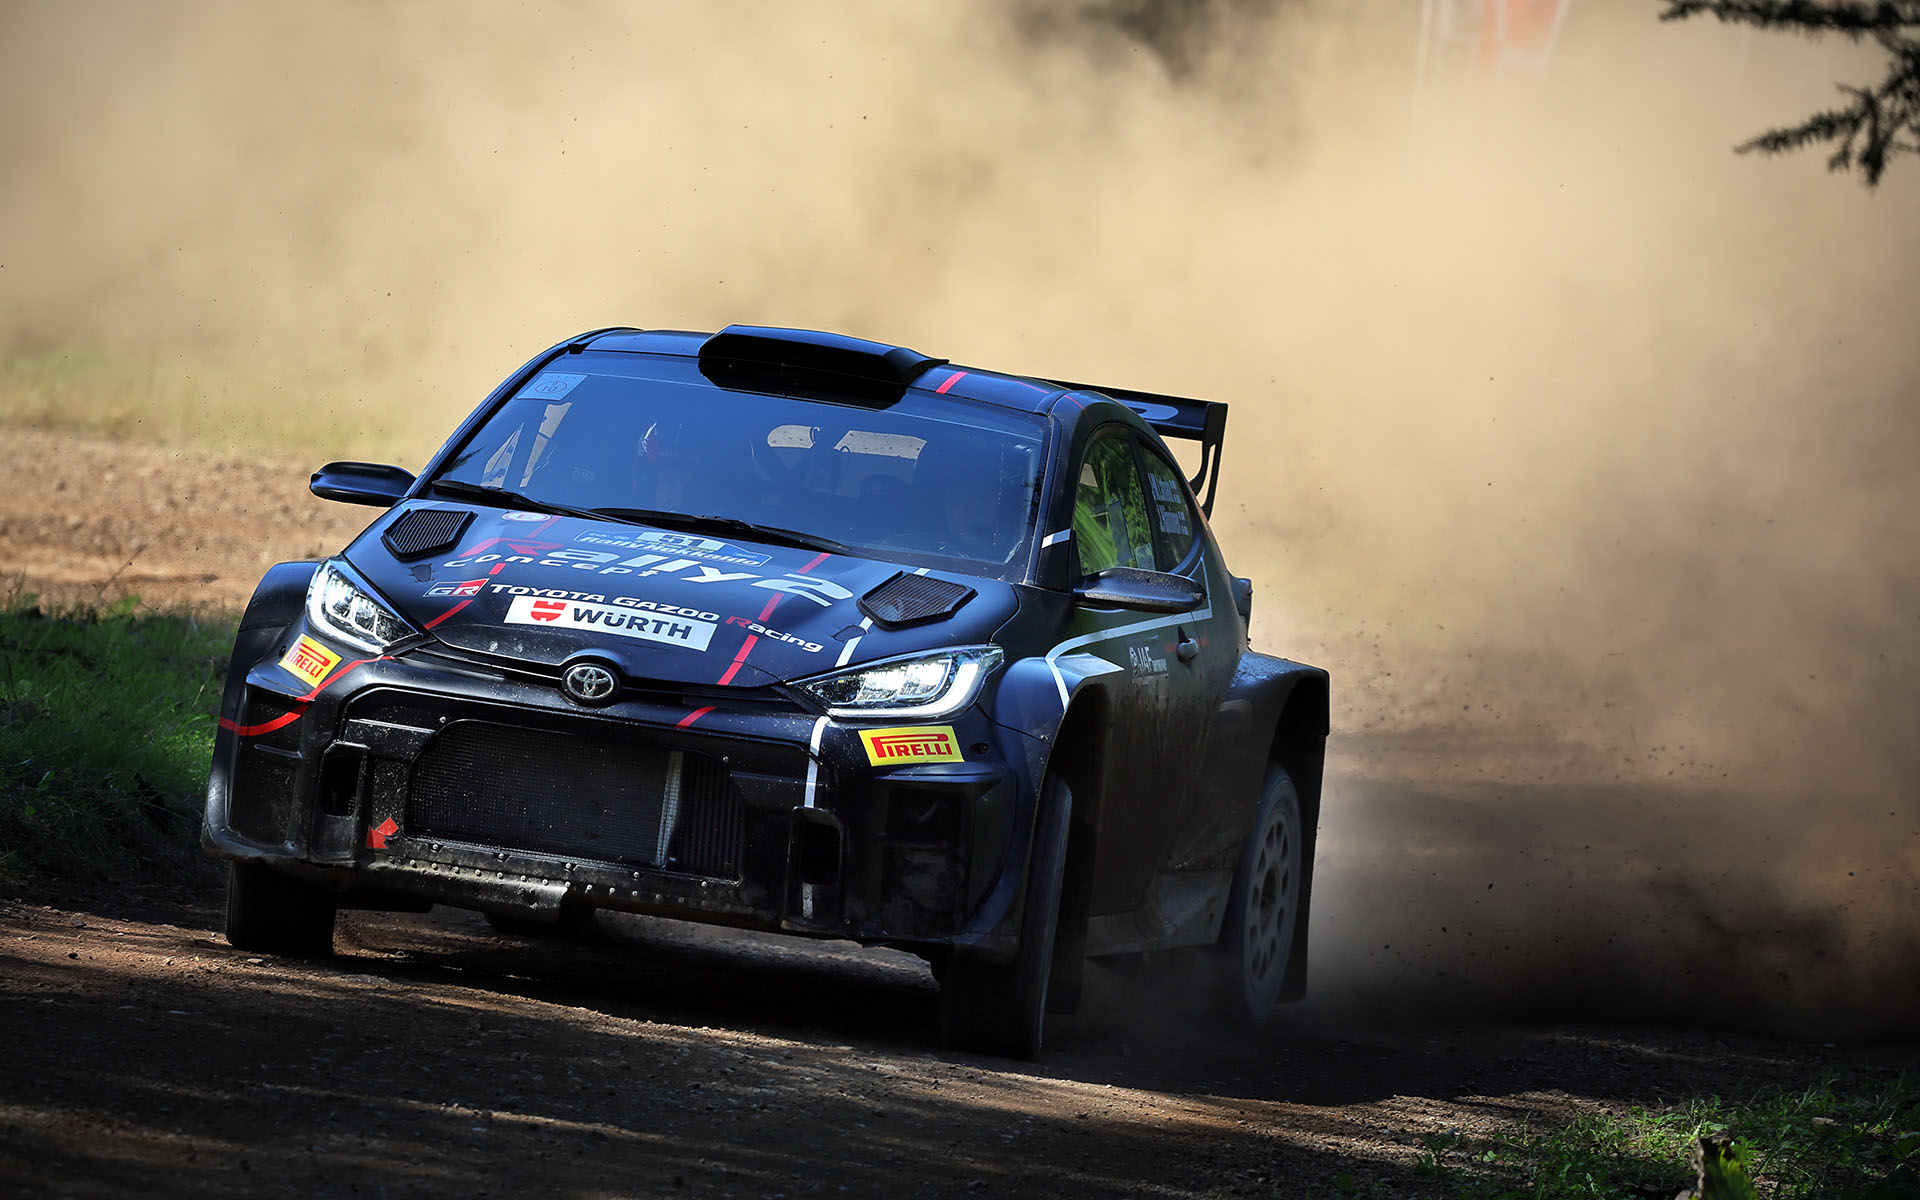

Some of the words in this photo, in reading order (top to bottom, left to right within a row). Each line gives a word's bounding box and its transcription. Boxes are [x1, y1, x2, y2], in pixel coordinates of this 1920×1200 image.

[659, 534, 706, 547] 51
[427, 585, 480, 596] GR
[489, 583, 608, 602] TOYOTA
[612, 596, 720, 622] GAZOO
[725, 615, 824, 653] Racing
[285, 642, 331, 679] PIRELLI
[870, 733, 953, 759] PIRELLI
